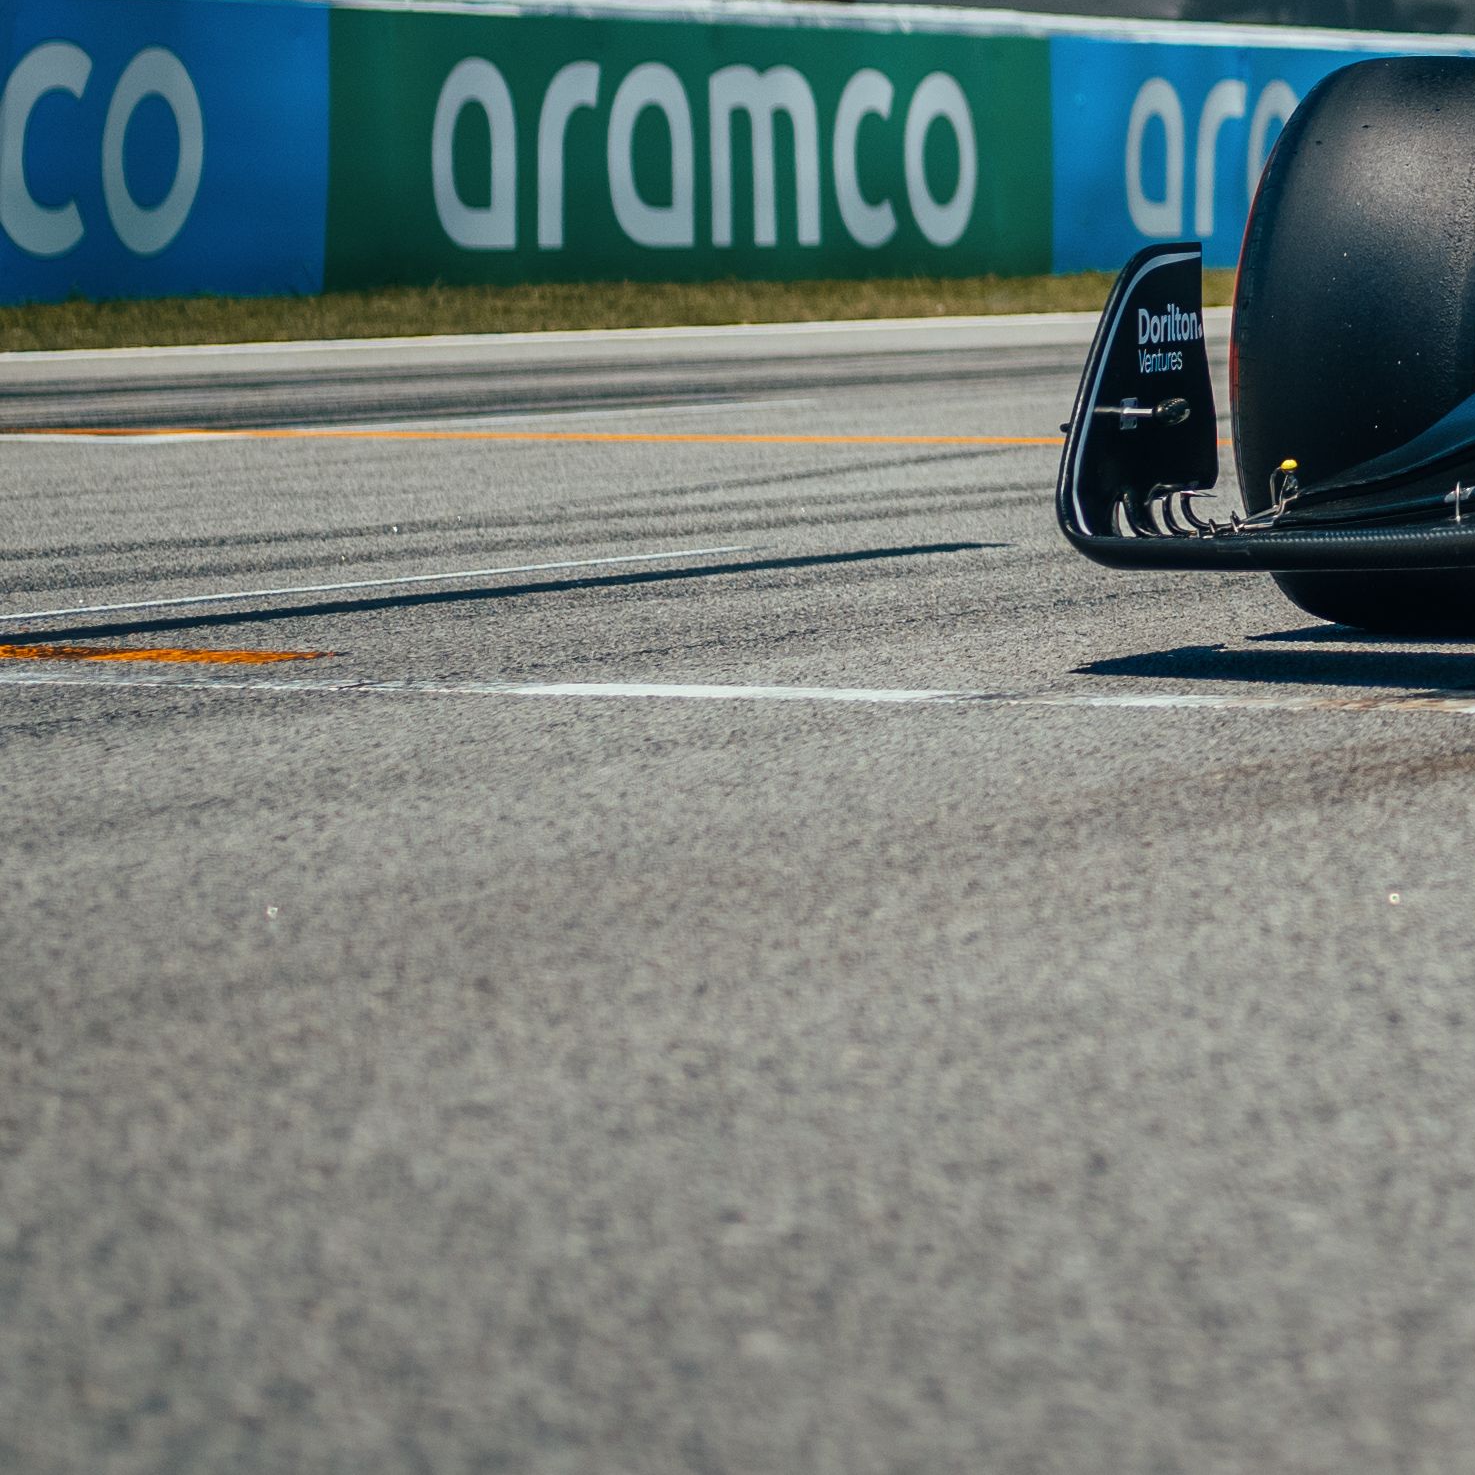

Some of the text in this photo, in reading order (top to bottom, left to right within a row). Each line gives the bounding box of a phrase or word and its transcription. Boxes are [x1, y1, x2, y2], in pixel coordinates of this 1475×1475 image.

[432, 58, 978, 250] aramco
[1138, 303, 1199, 345] Dorilton
[1138, 347, 1183, 374] Ventures
